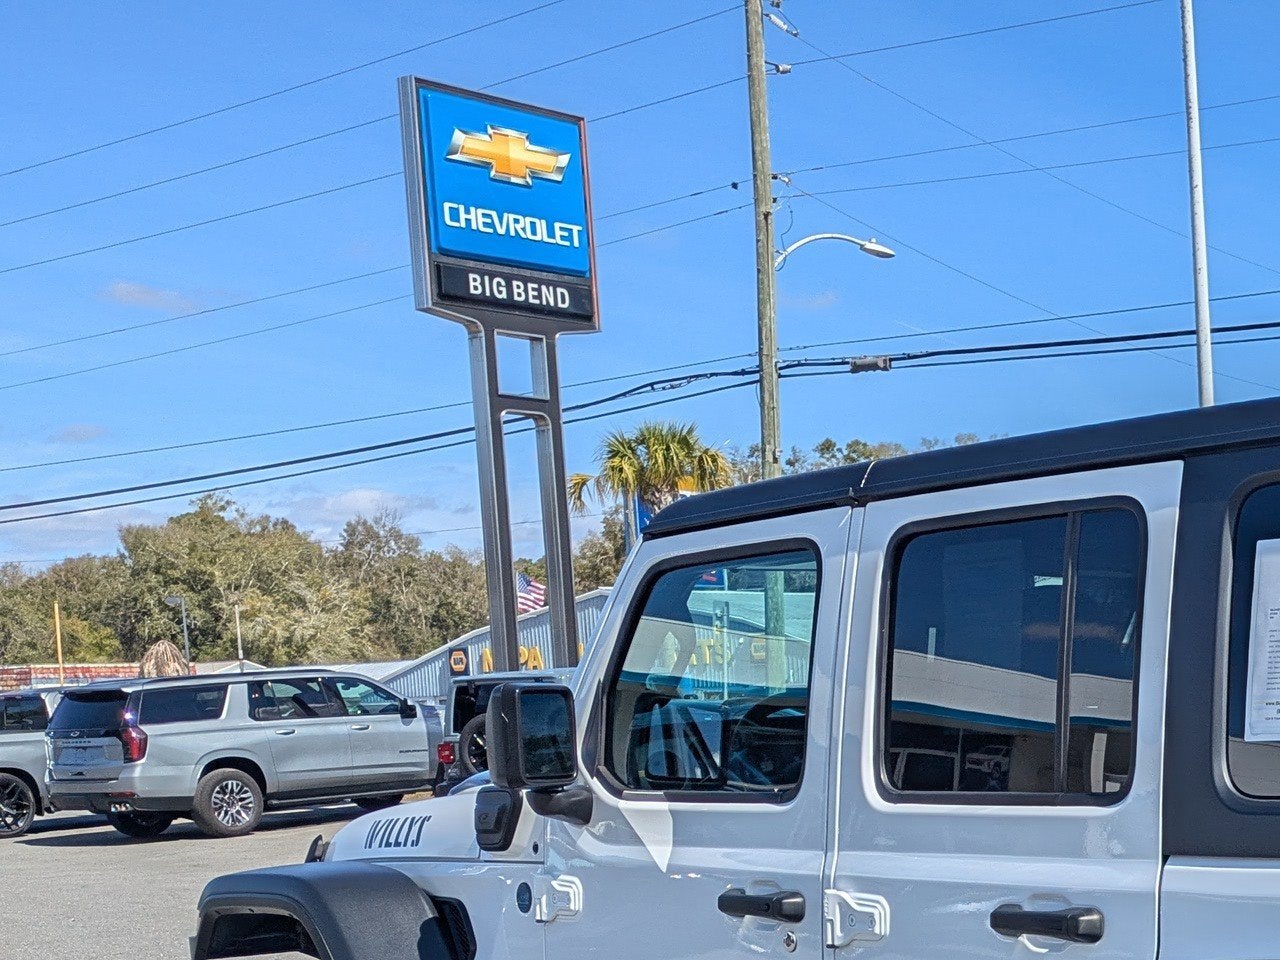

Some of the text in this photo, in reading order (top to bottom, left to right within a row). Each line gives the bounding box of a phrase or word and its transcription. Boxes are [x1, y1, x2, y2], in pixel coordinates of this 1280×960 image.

[443, 202, 582, 247] CHEVROLET
[468, 273, 570, 309] BIG BEND
[481, 645, 545, 674] NPA
[364, 815, 432, 849] WILLYS
